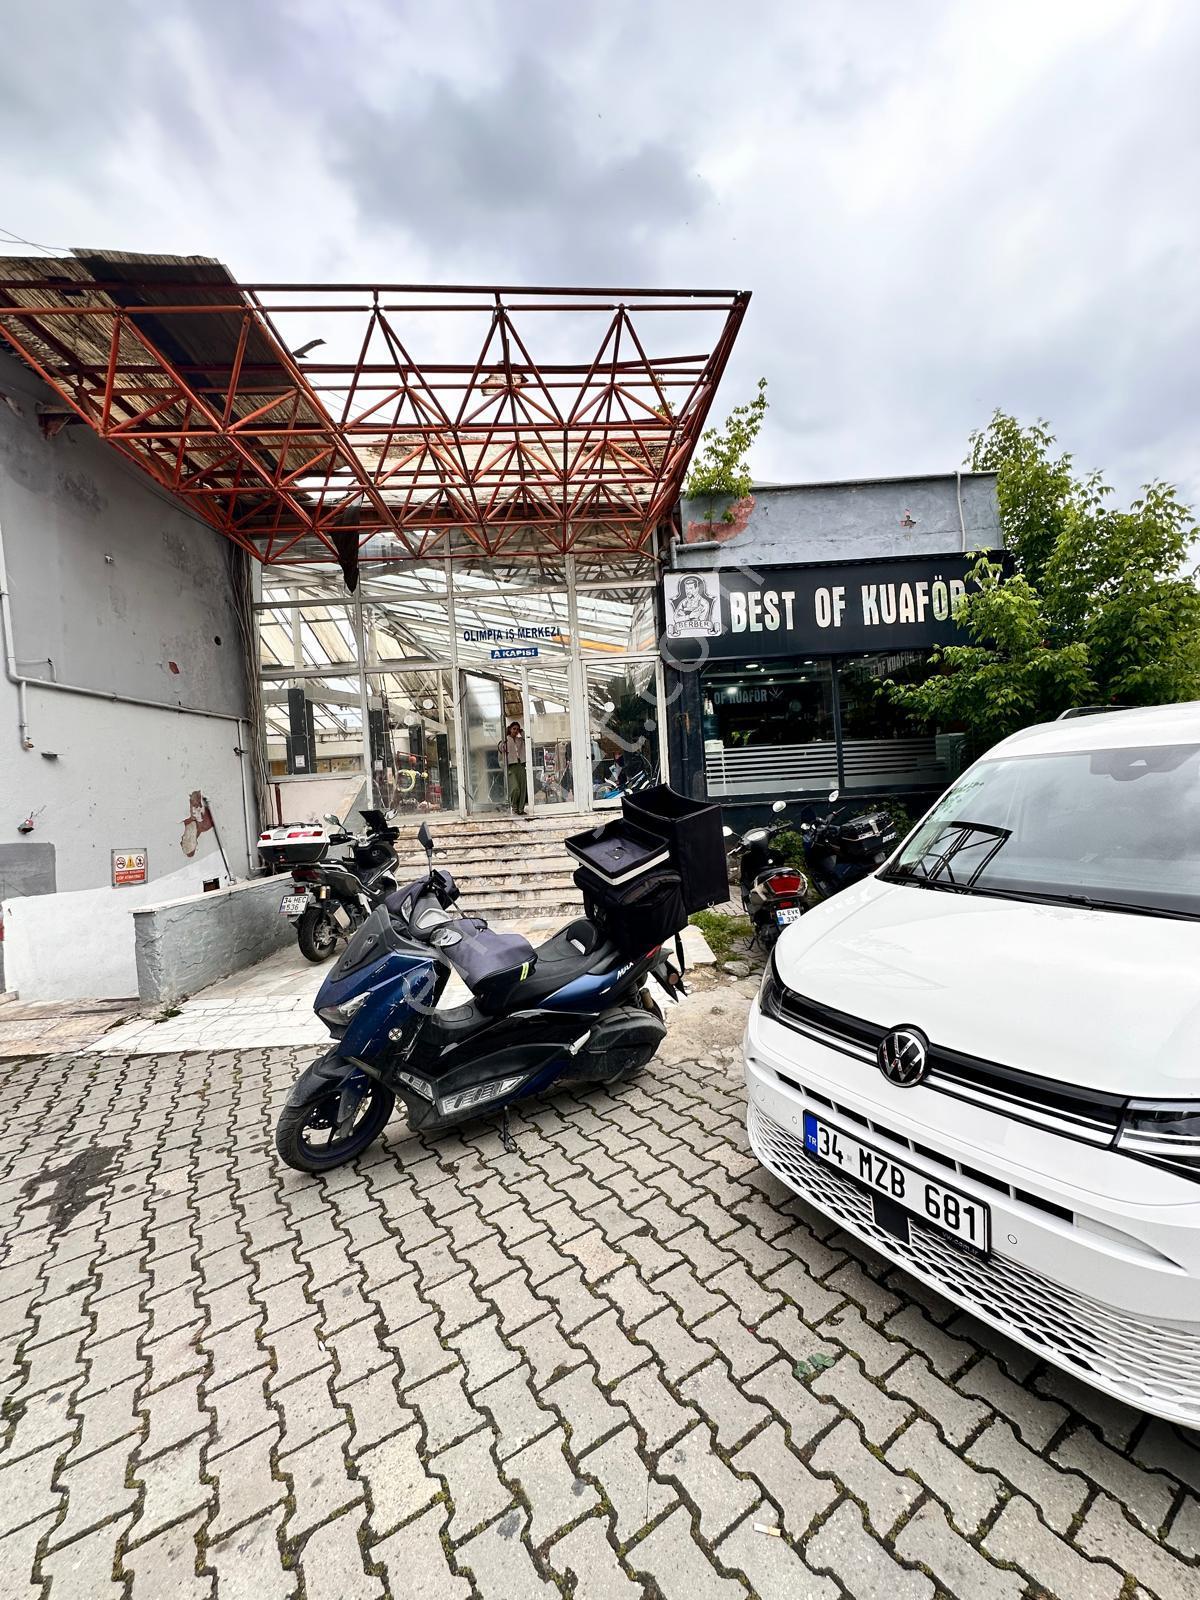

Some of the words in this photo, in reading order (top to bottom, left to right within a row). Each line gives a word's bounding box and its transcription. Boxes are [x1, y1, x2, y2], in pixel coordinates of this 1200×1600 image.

[730, 590, 796, 633] BEST
[814, 586, 846, 628] OF
[861, 574, 966, 626] KUAFÖR
[518, 626, 560, 638] MERKEZİ
[503, 649, 535, 657] KAPISI
[807, 1134, 817, 1147] TR
[818, 1127, 844, 1165] 34
[859, 1148, 906, 1199] MZB
[924, 1184, 976, 1241] 681
